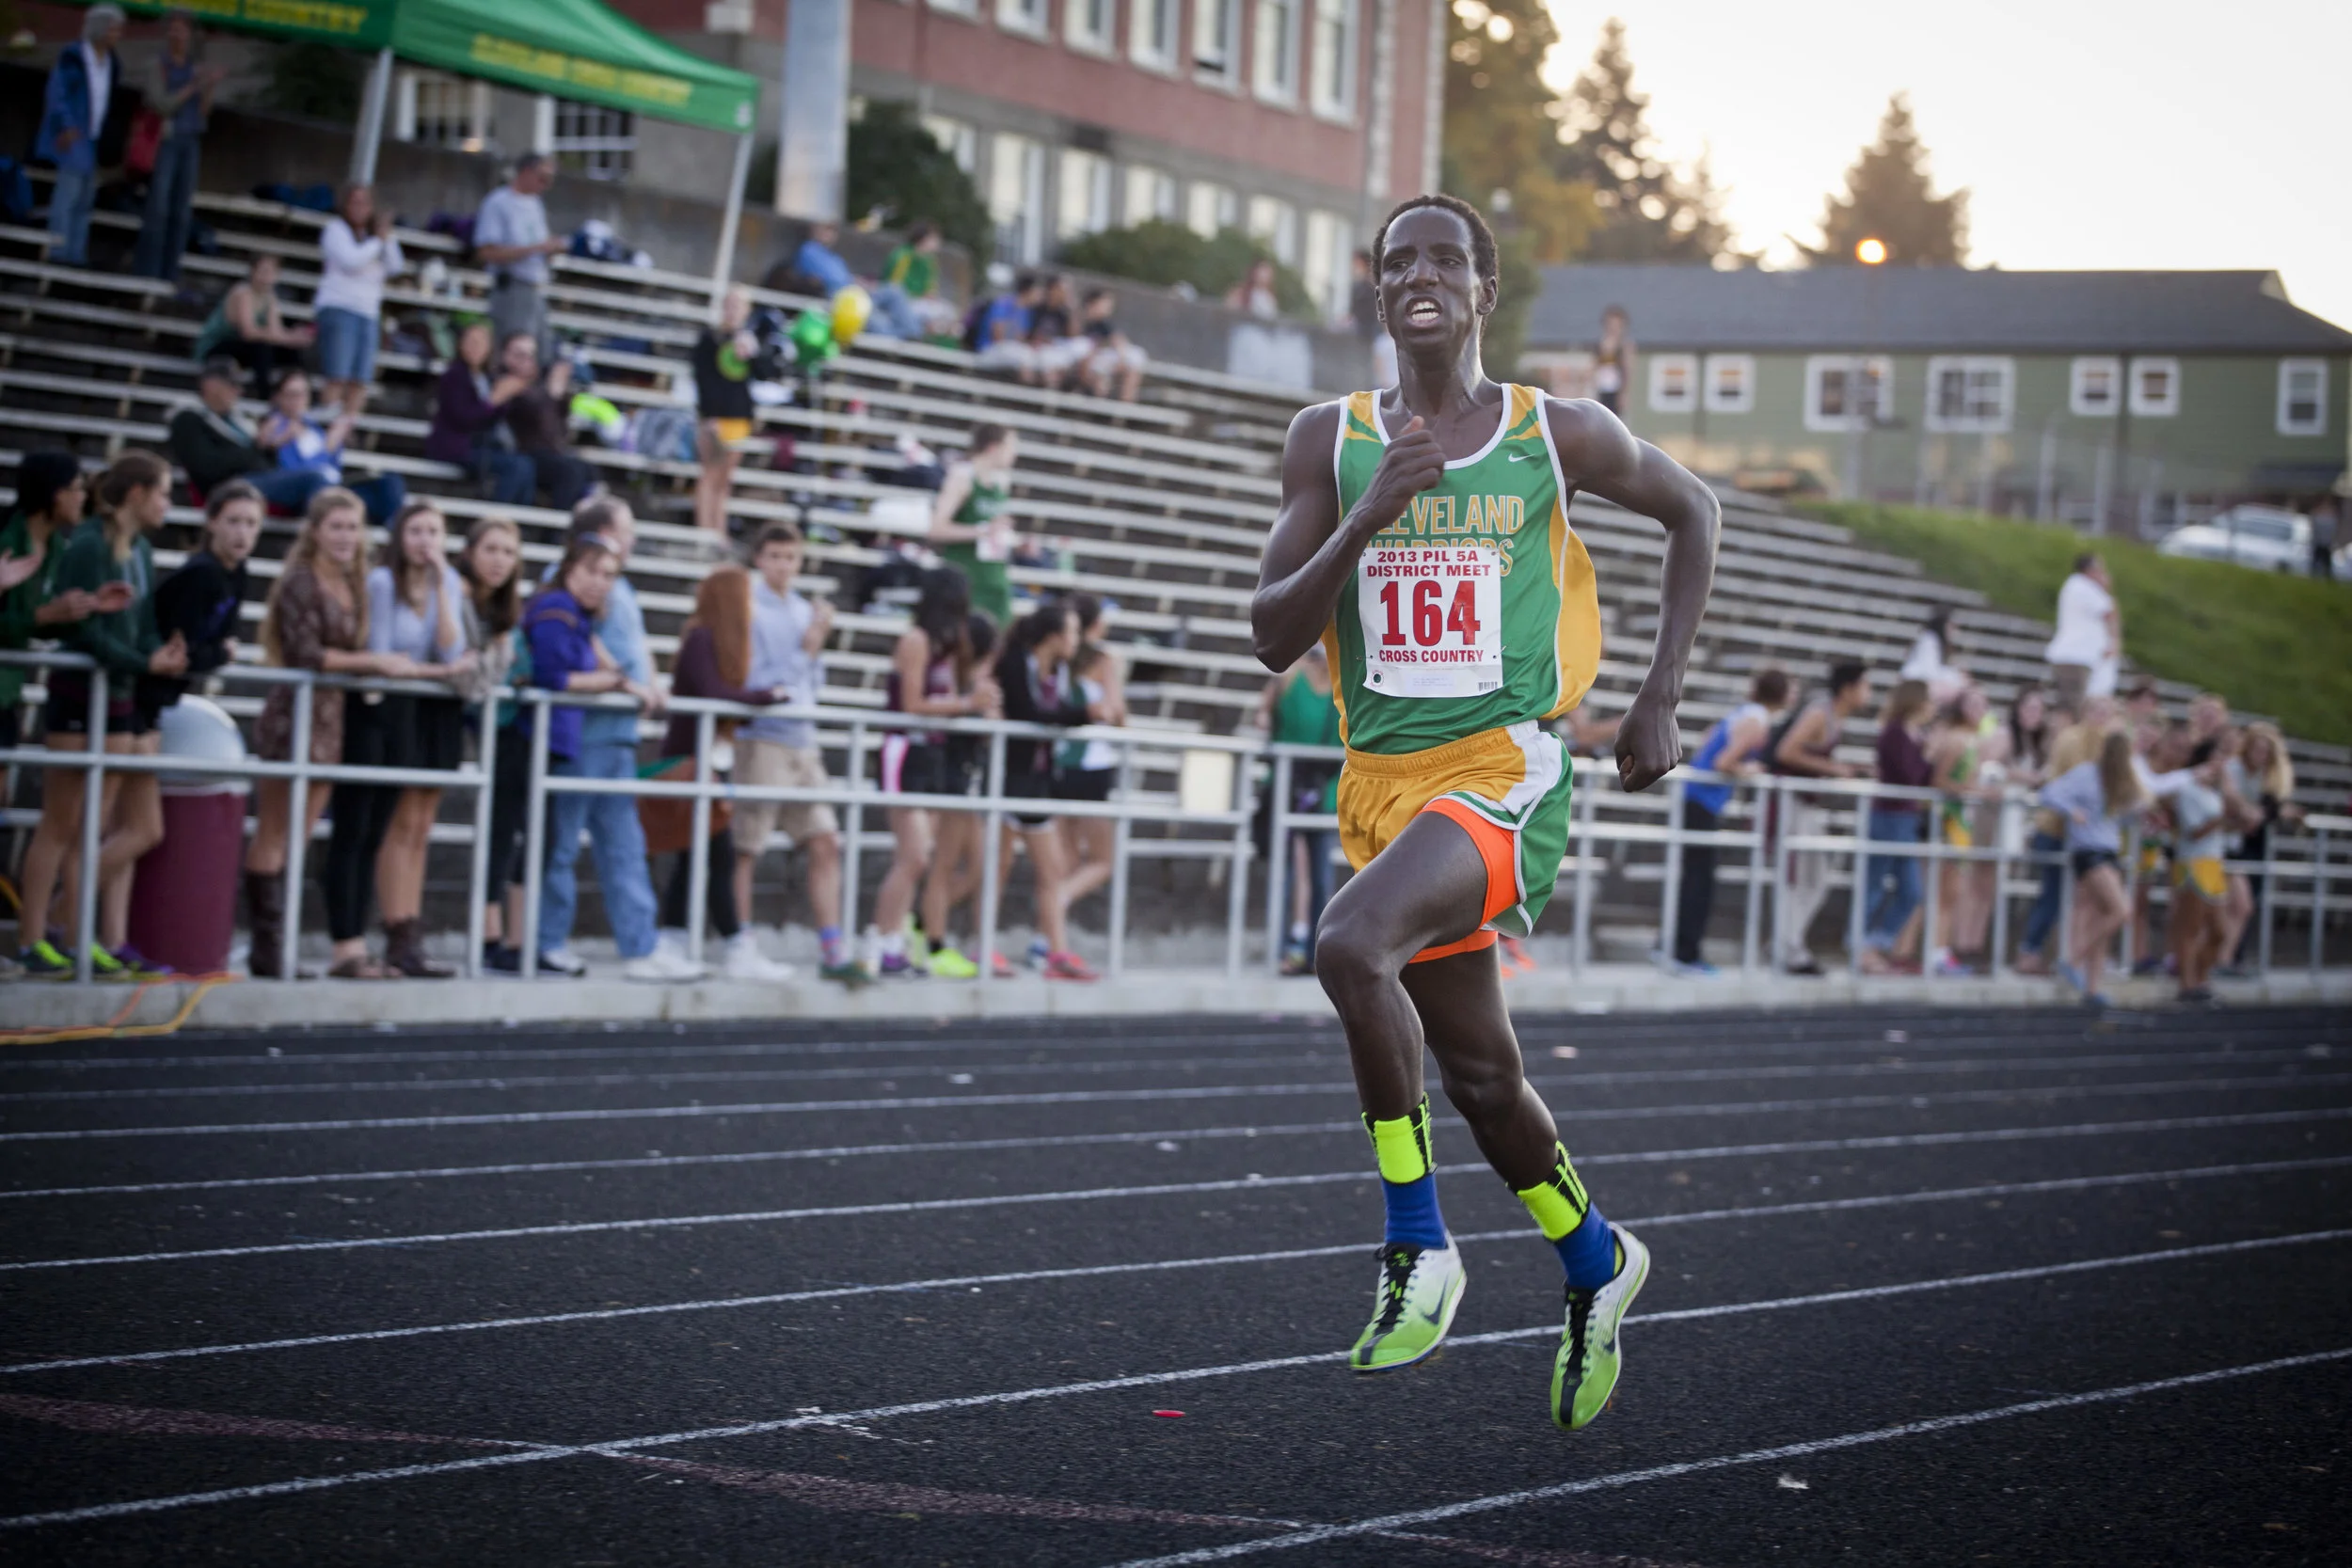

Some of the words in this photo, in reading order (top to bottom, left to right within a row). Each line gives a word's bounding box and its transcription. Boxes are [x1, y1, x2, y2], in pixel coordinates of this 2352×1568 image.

[1376, 494, 1525, 535] EVELAND
[1377, 550, 1417, 562] 2013
[1422, 550, 1451, 562] PIL
[1456, 550, 1479, 562] 5A
[1367, 565, 1440, 578] DISTRICT
[1446, 564, 1491, 577] MEET
[1380, 579, 1481, 647] 164
[1379, 650, 1417, 662] CROSS
[1421, 649, 1484, 662] COUNTRY
